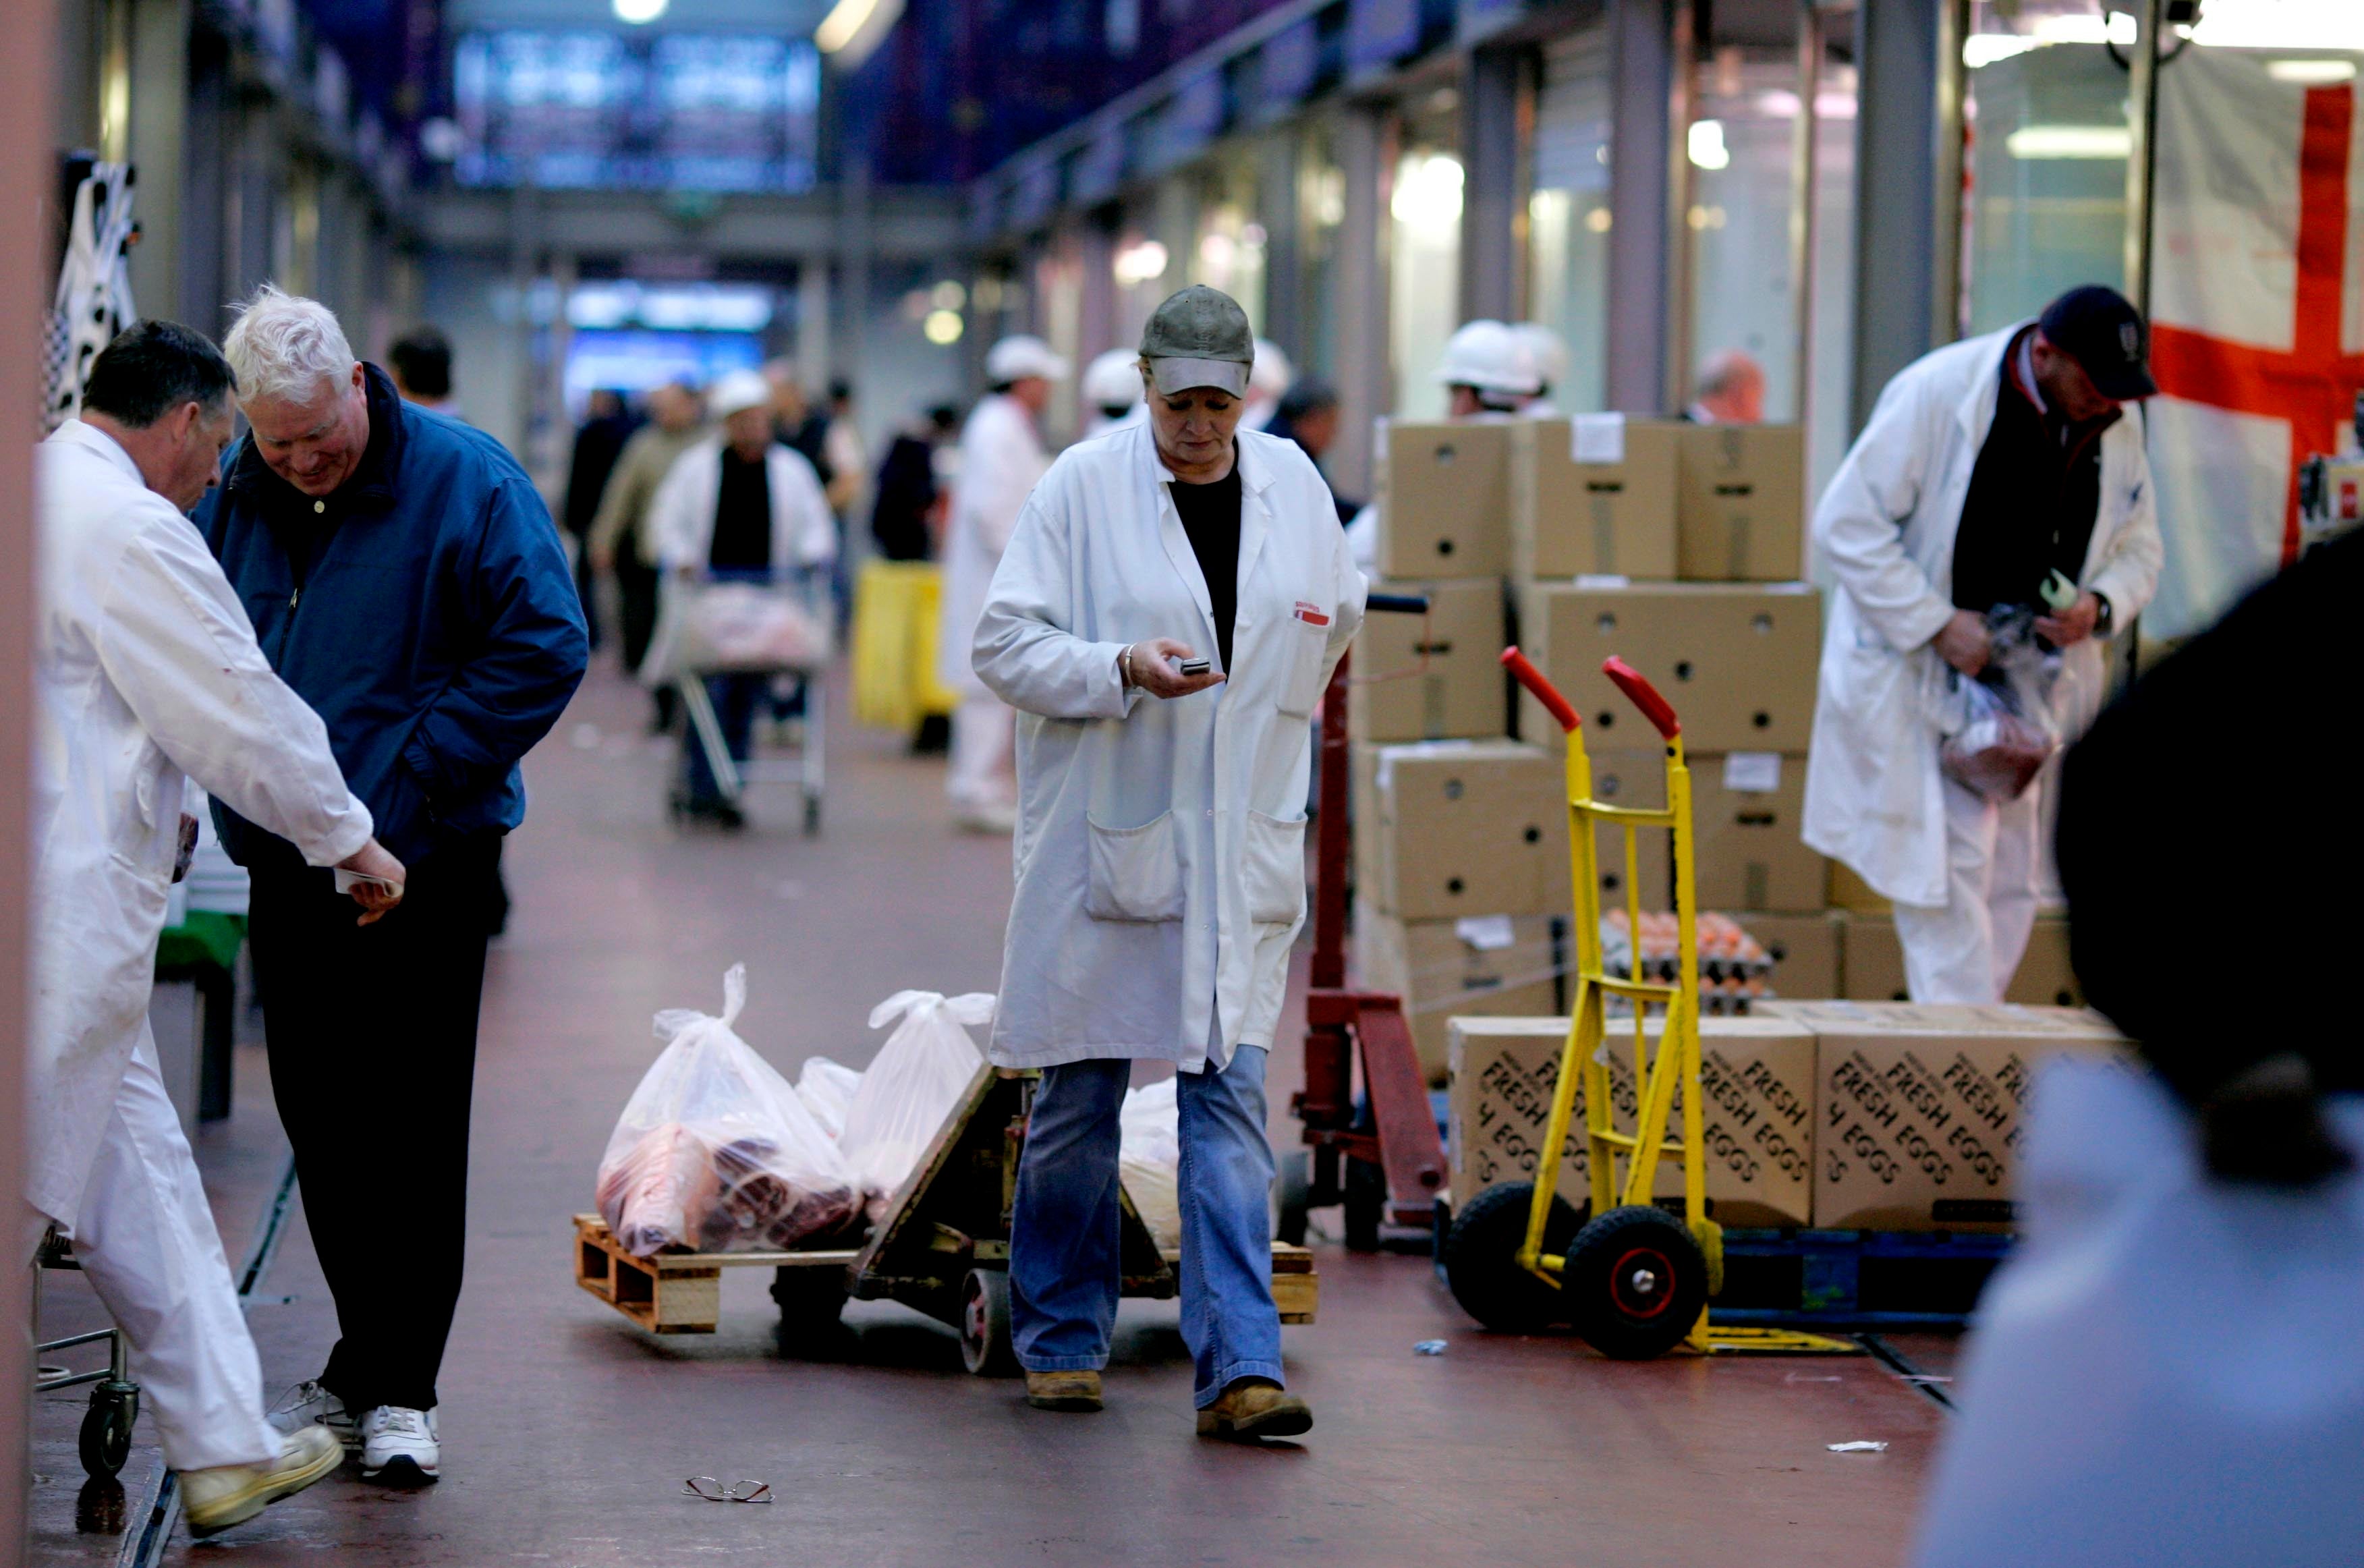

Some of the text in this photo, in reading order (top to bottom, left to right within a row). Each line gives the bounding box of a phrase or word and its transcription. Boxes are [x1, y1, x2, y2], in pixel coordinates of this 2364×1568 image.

[1482, 1061, 1548, 1127] FRESH
[1744, 1059, 1807, 1126] FRESH
[1834, 1061, 1898, 1127] FRESH
[1895, 1125, 1953, 1185] EGGS
[1886, 1061, 1950, 1128] FRESH
[1948, 1126, 2005, 1186] EGGS
[1943, 1063, 2008, 1129] FRESH
[1704, 1122, 1760, 1182] EGGS
[1755, 1123, 1809, 1181] EGGS
[1842, 1122, 1901, 1184] EGGS
